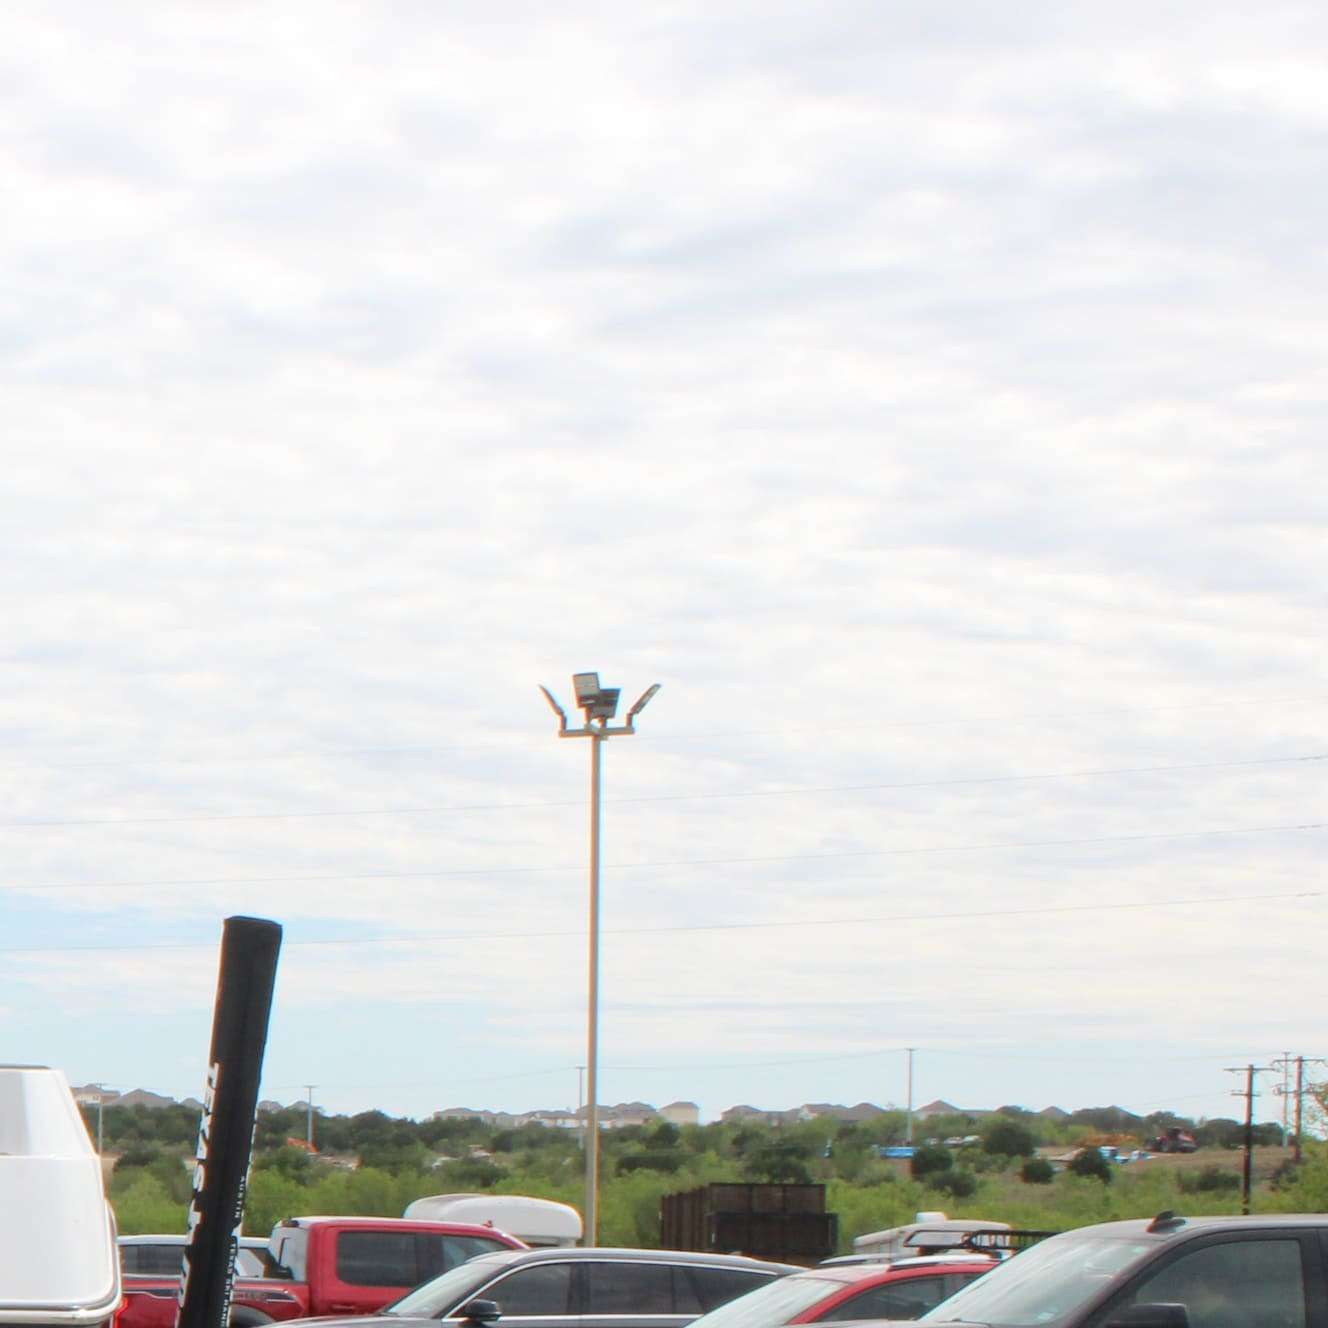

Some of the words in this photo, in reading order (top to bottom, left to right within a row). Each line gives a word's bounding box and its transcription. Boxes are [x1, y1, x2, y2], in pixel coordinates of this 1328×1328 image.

[233, 1175, 247, 1219] AUSTIN
[225, 1242, 237, 1275] TEXAS
[223, 1278, 232, 1297] SKI
